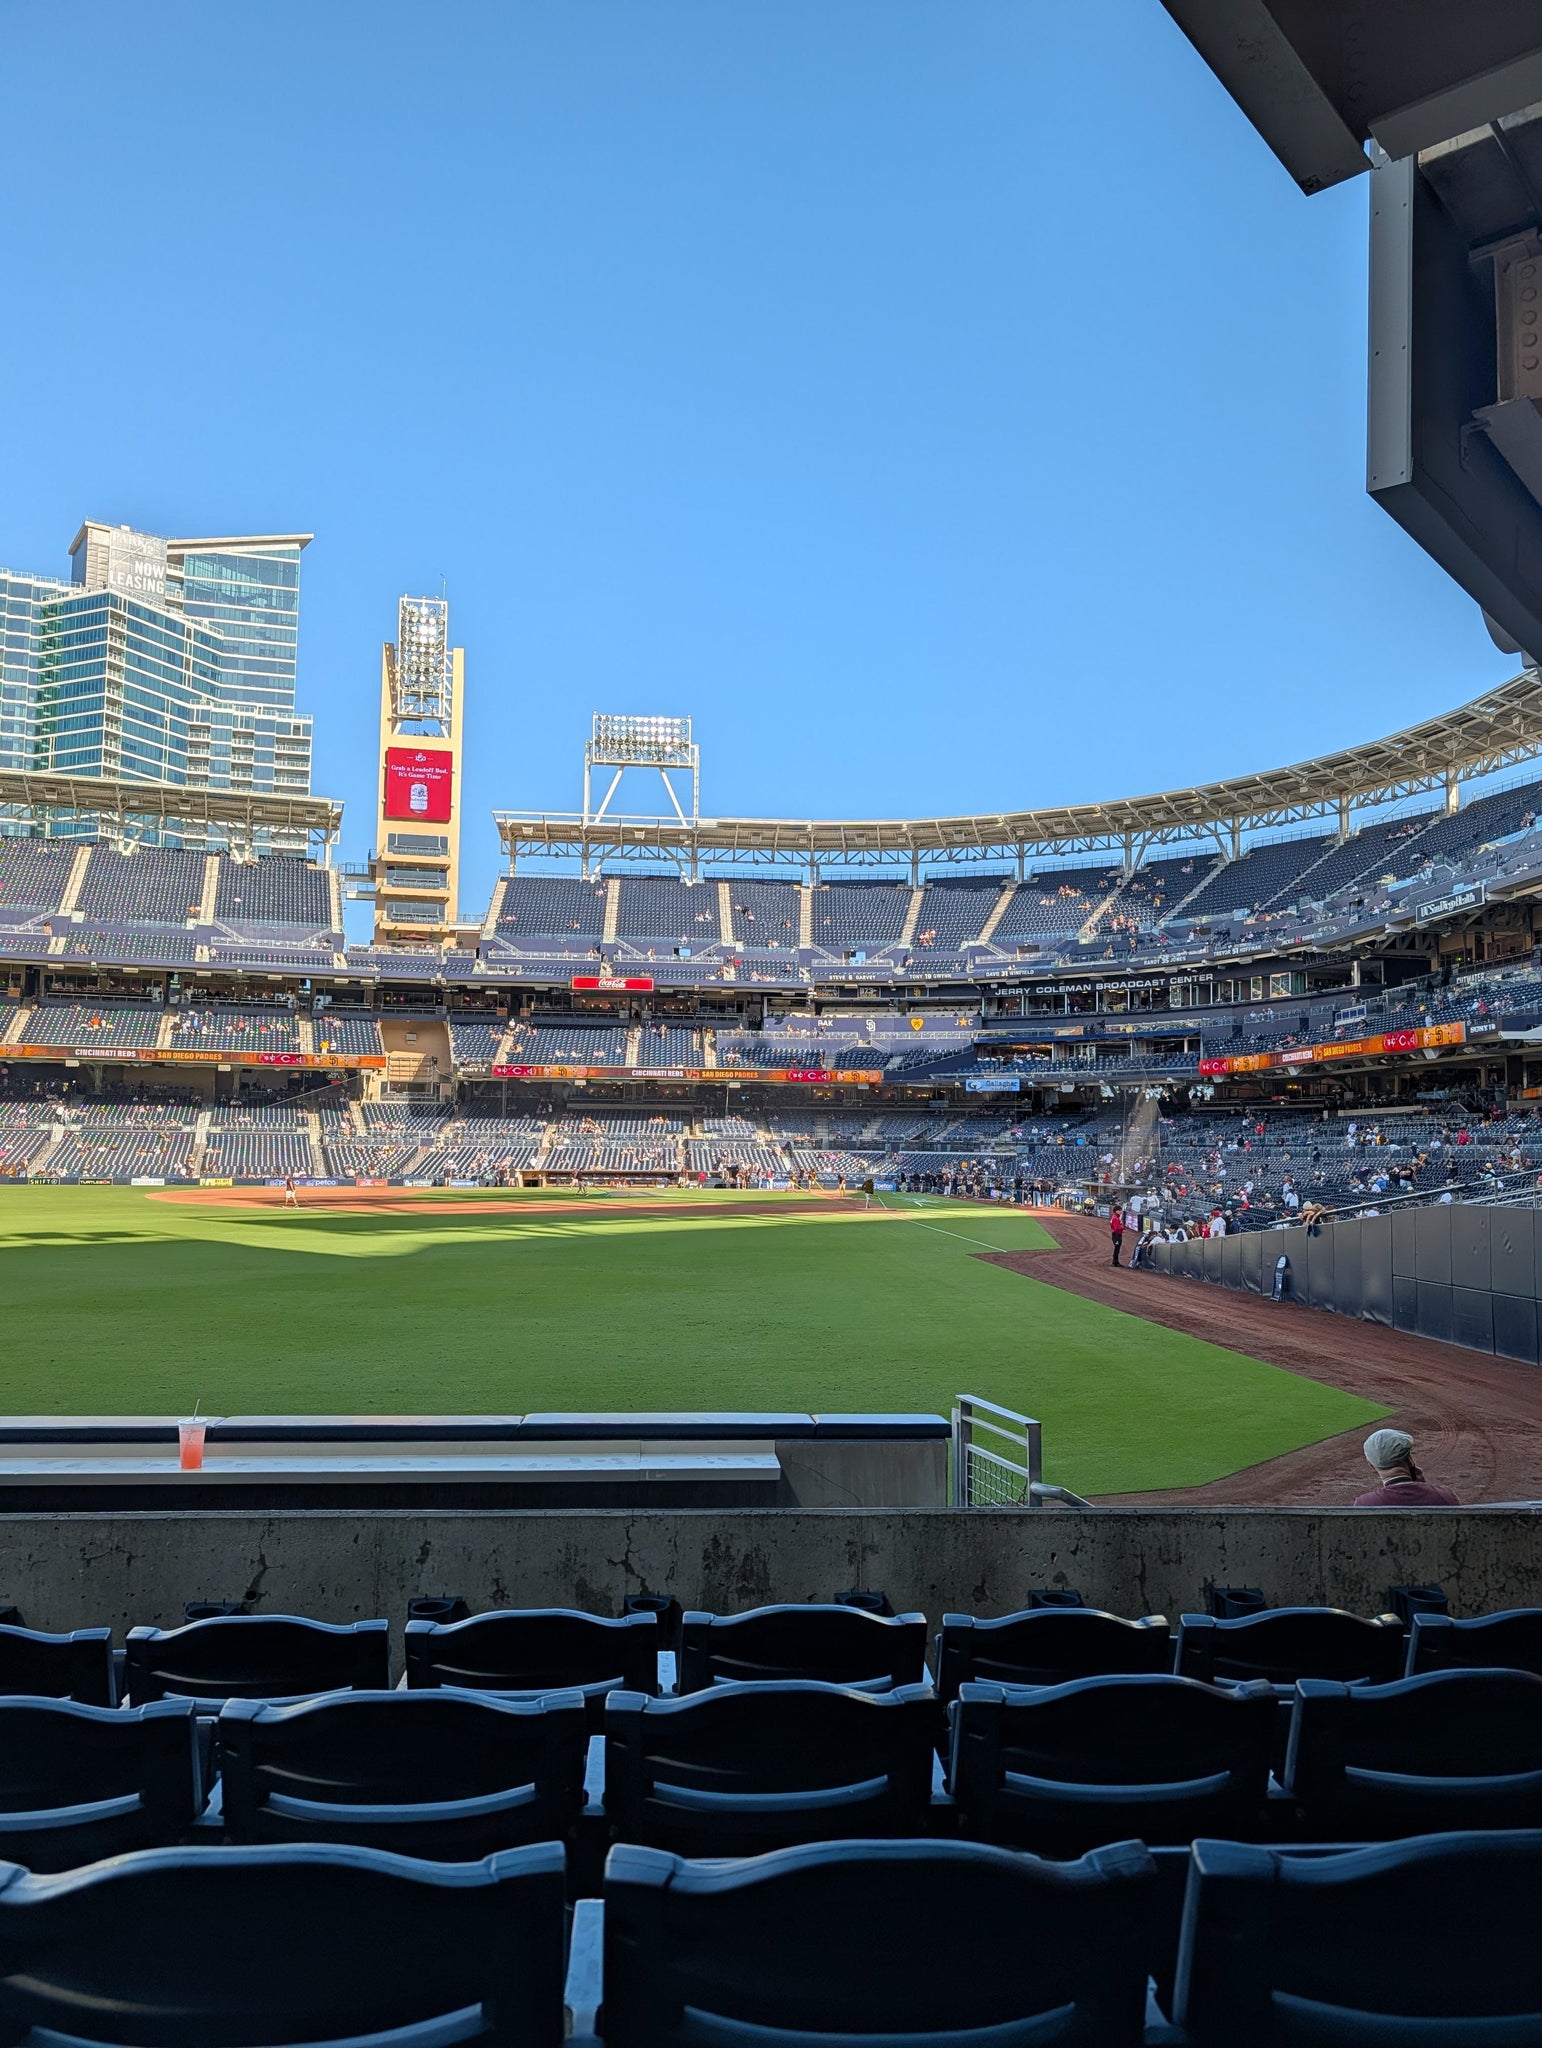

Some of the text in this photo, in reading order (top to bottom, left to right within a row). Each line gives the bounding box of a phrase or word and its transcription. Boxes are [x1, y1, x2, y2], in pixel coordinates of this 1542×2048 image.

[135, 560, 165, 579] NOW
[109, 570, 165, 595] LEASING
[995, 973, 1214, 996] JERRY COLEMAN BROADCAST CENTER
[75, 1049, 117, 1057] CINCINNATI
[117, 1050, 137, 1058] REDS
[172, 1052, 195, 1060] DIEGO
[631, 1069, 667, 1077] CINCINNATI
[315, 1179, 336, 1187] petco
